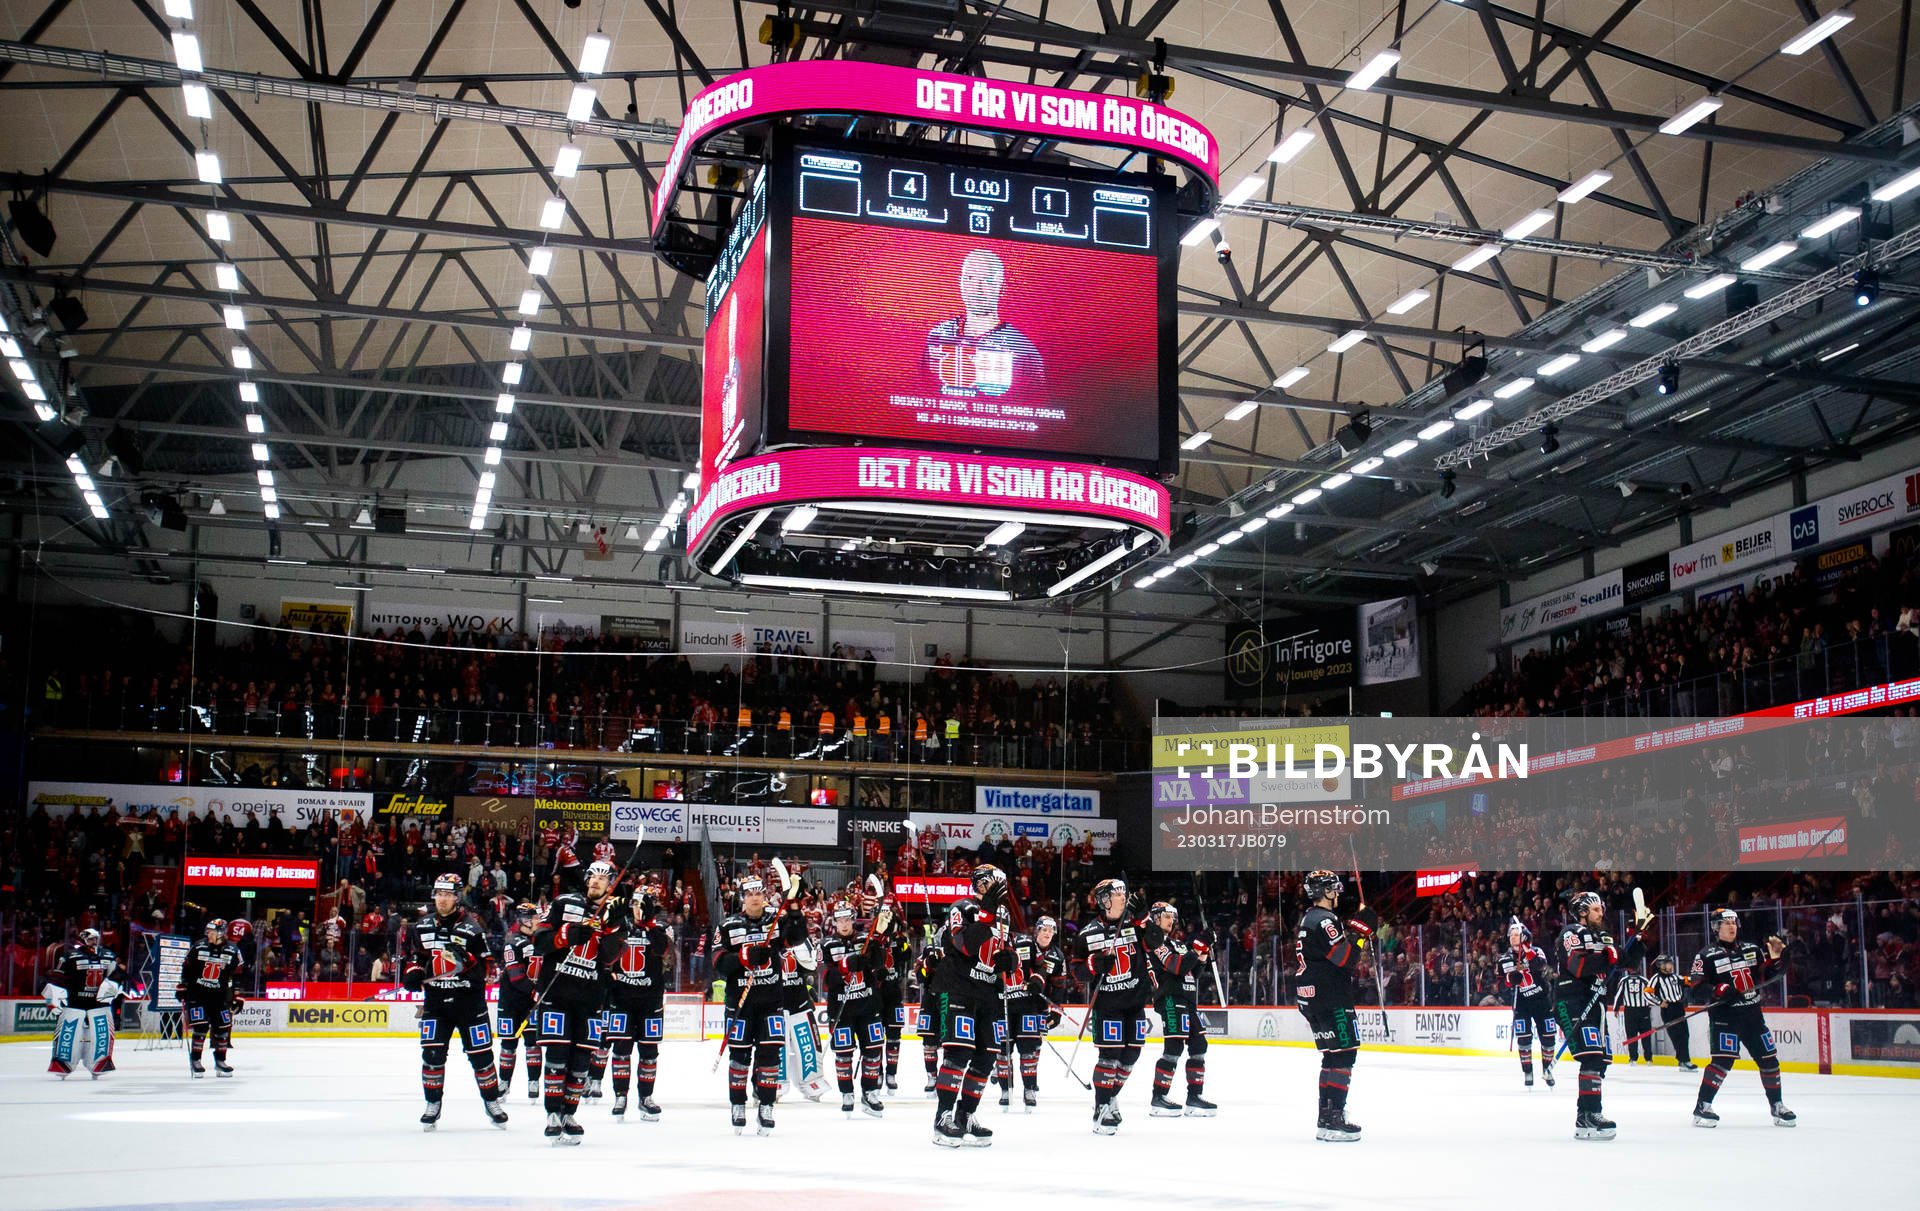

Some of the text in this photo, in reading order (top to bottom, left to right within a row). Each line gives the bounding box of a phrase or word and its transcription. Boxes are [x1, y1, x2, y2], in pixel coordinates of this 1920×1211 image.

[917, 78, 1209, 163] DET ÄR VI SOM ÄR ÖREBRO
[904, 178, 917, 196] 4
[1043, 194, 1052, 211] 1
[859, 456, 1159, 518] DET ÄR VI SOM ÄR ÖREBRO
[1838, 491, 1895, 522] SWEROCK
[1735, 531, 1772, 553] BEIJER
[1700, 552, 1718, 570] fm
[1627, 571, 1666, 592] SNICKARE
[685, 632, 729, 647] Lindahl
[753, 628, 814, 645] TRAVEL
[1291, 667, 1326, 681] lounge
[1327, 663, 1353, 676] 2023
[1159, 780, 1196, 801] NA
[1207, 776, 1245, 799] NA
[1261, 780, 1320, 793] Swedbank
[535, 799, 611, 812] Mekonomen
[984, 789, 1093, 813] Vintergatan
[615, 807, 682, 822] ESSWEGE
[692, 814, 761, 827] HERCULES
[670, 826, 684, 834] AB
[847, 819, 901, 834] SERNEKE
[1741, 838, 1756, 853] DET
[1778, 833, 1797, 849] SOM
[188, 864, 316, 880] DET ÄR VI SOM ÄR ÖREBRO
[896, 883, 913, 895] DET
[926, 884, 935, 895] VI
[936, 885, 956, 896] SOM
[956, 884, 969, 896] ÄR
[233, 926, 246, 937] 54
[259, 1018, 271, 1026] AB
[1416, 1013, 1461, 1032] FANTASY
[60, 1024, 75, 1060] HEROK
[96, 1017, 107, 1055] HEROK
[1431, 1032, 1445, 1044] SHL
[797, 1026, 814, 1072] HEROK
